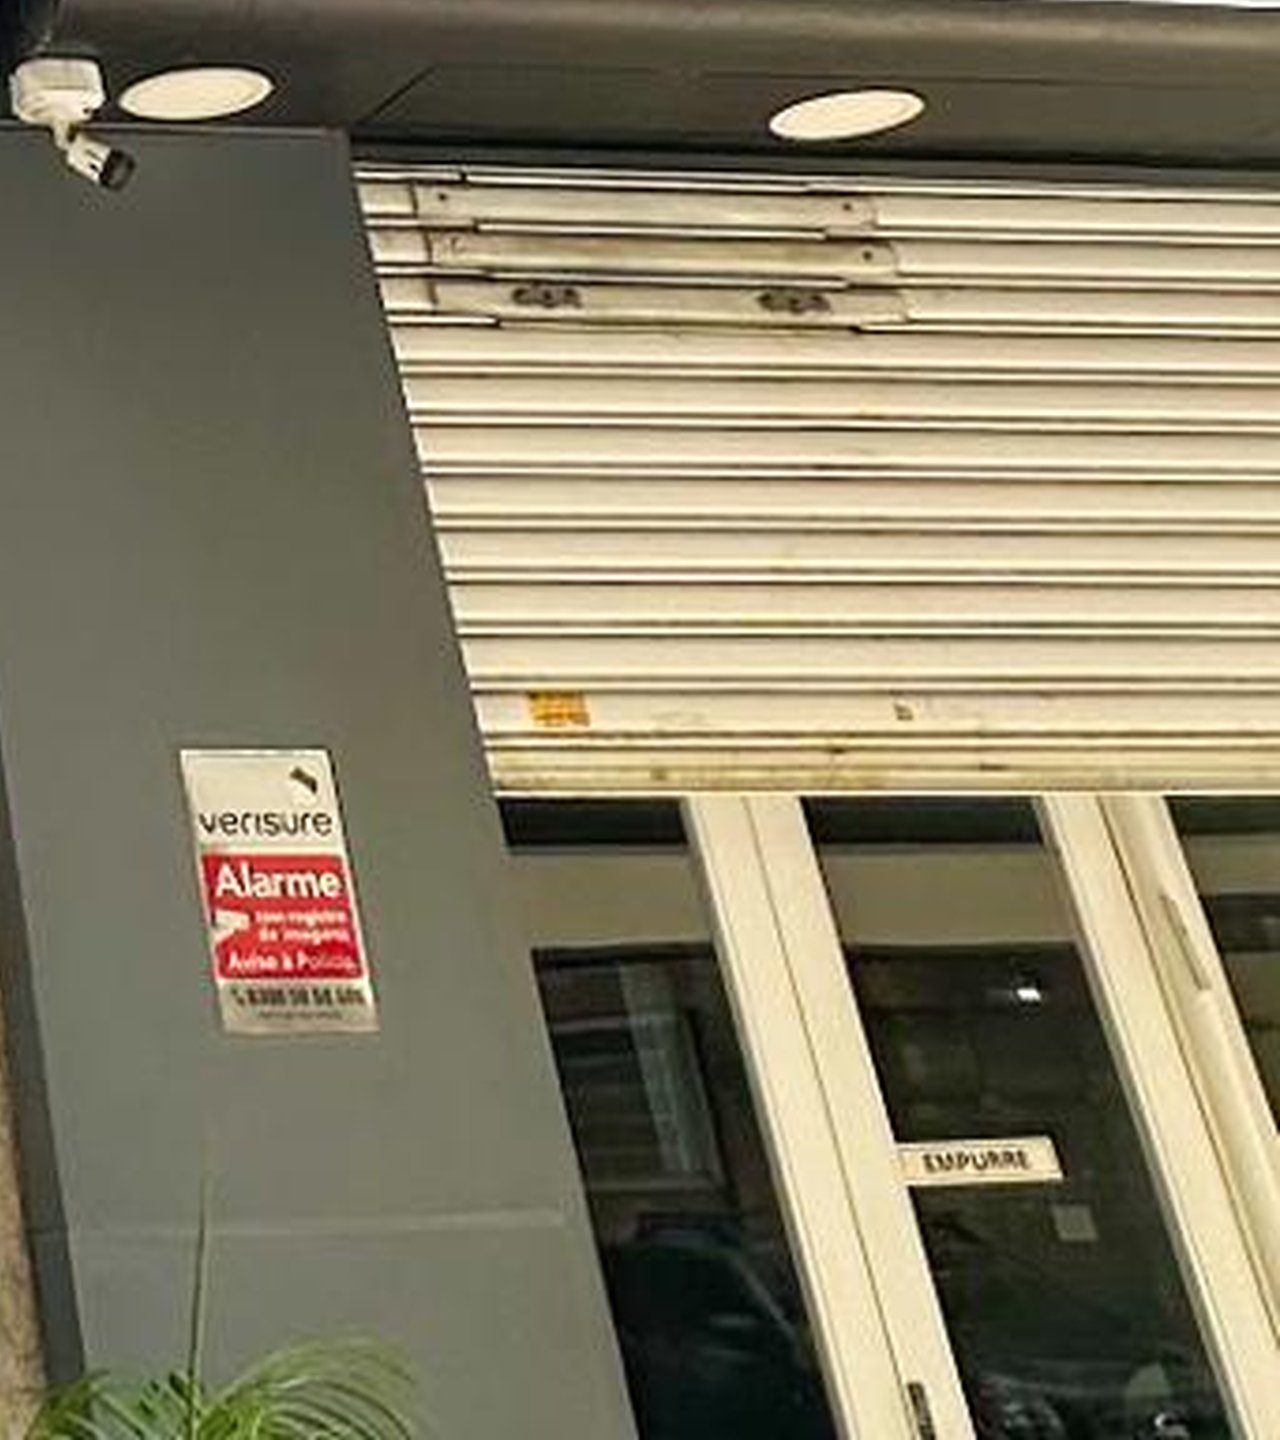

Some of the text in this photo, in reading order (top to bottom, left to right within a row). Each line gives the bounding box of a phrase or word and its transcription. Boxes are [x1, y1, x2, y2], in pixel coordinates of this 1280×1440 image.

[198, 811, 333, 837] verisure
[215, 861, 342, 898] Alarme
[922, 1149, 1033, 1174] EMPURRE
